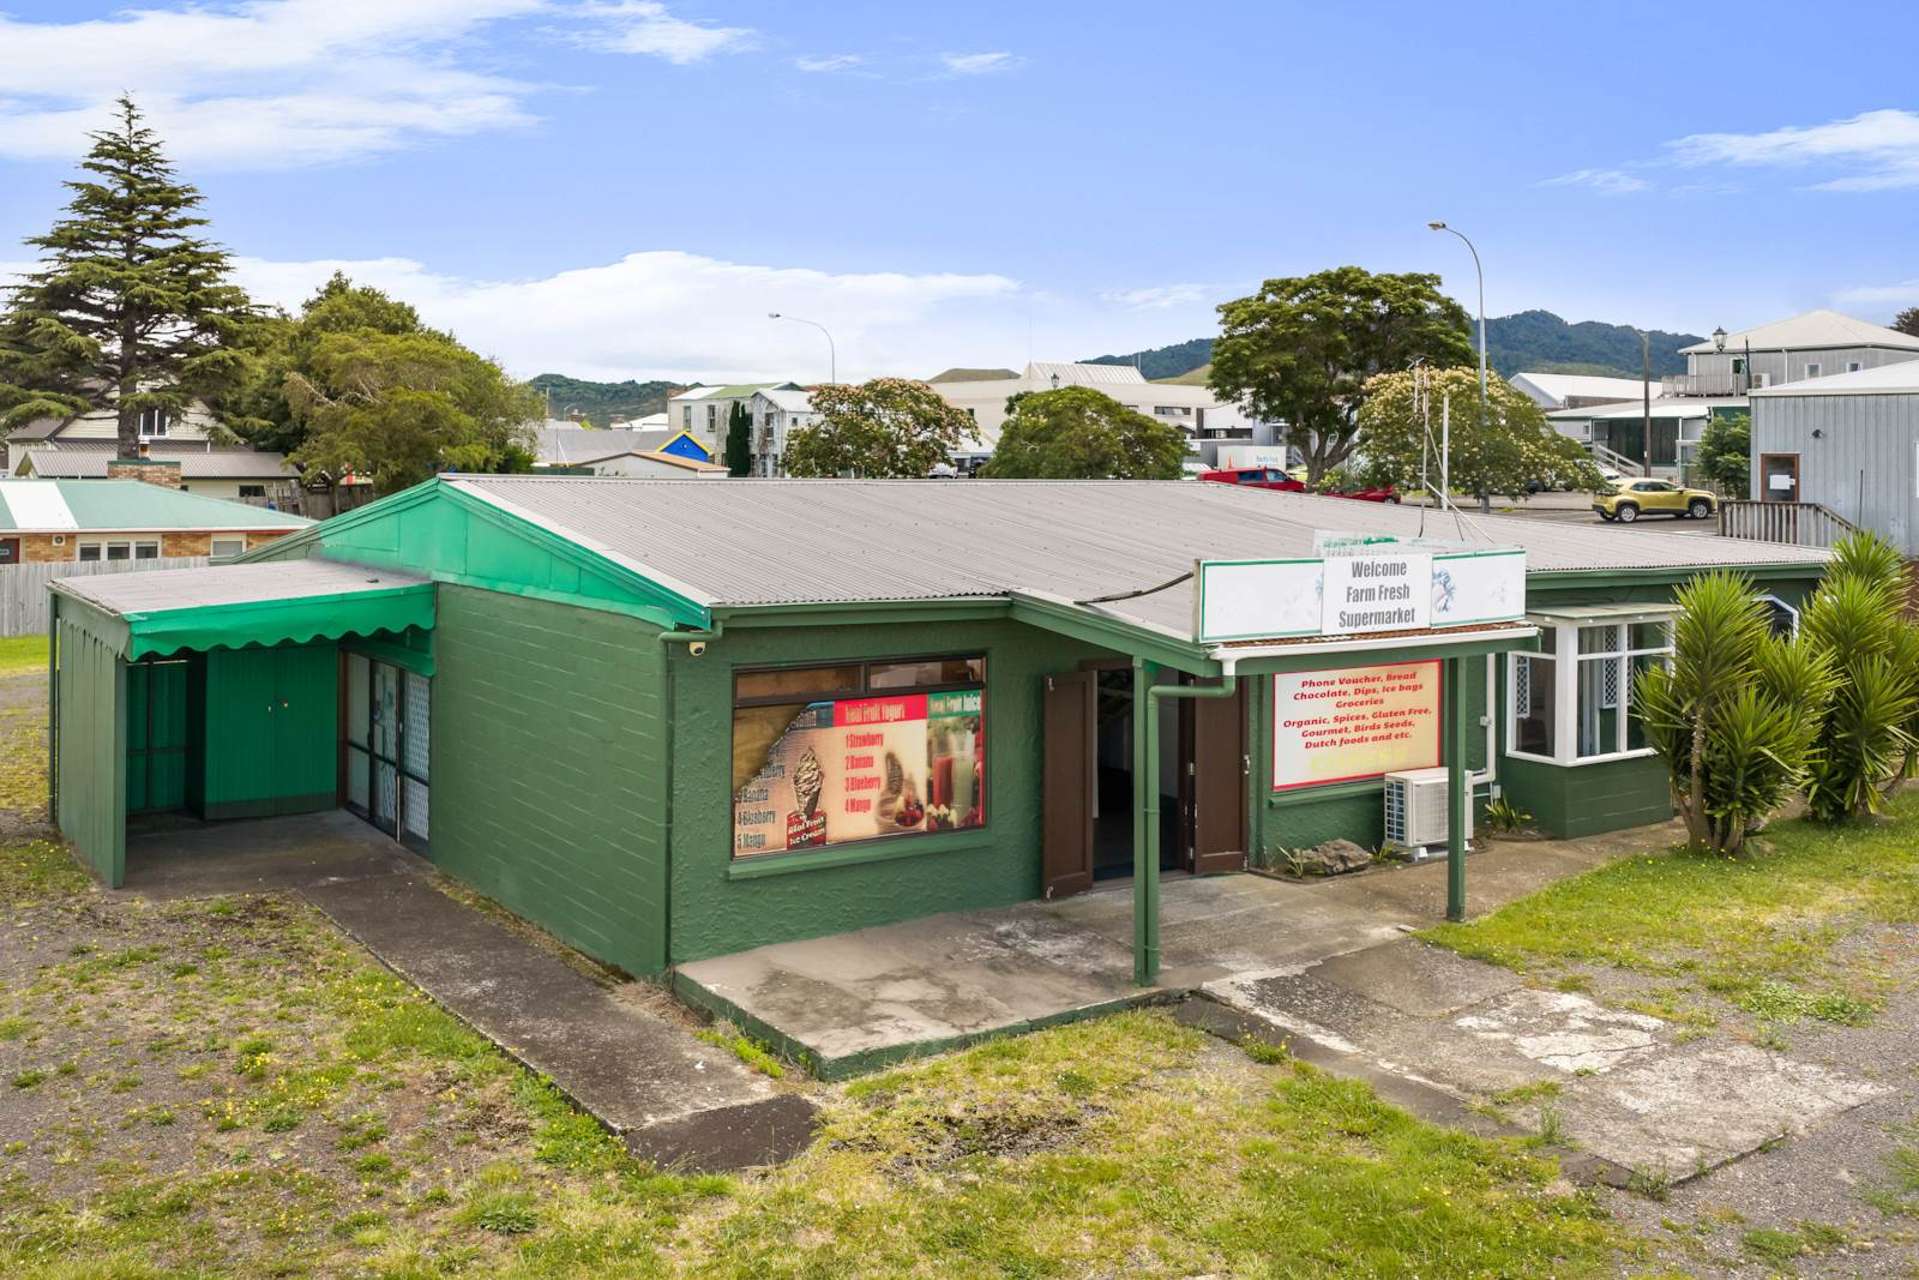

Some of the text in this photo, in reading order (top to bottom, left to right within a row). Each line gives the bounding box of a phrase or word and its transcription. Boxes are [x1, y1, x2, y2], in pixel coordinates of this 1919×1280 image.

[1352, 561, 1407, 578] Welcome
[1346, 583, 1410, 603] Farm Fresh
[1339, 607, 1416, 628] Supermarket
[1301, 671, 1417, 688] Phone Voucher, Bread
[1293, 689, 1351, 700] Chocolate,
[1382, 685, 1396, 693] Ice
[1398, 683, 1423, 693] bags
[1336, 698, 1384, 709] Groceries
[1283, 706, 1432, 729] Organic, Spices, Gluten Free,
[1301, 719, 1416, 738] Gourmet, Birds Seeds,
[1305, 739, 1337, 749] Dutch
[1339, 736, 1369, 747] foods
[1371, 733, 1392, 742] and
